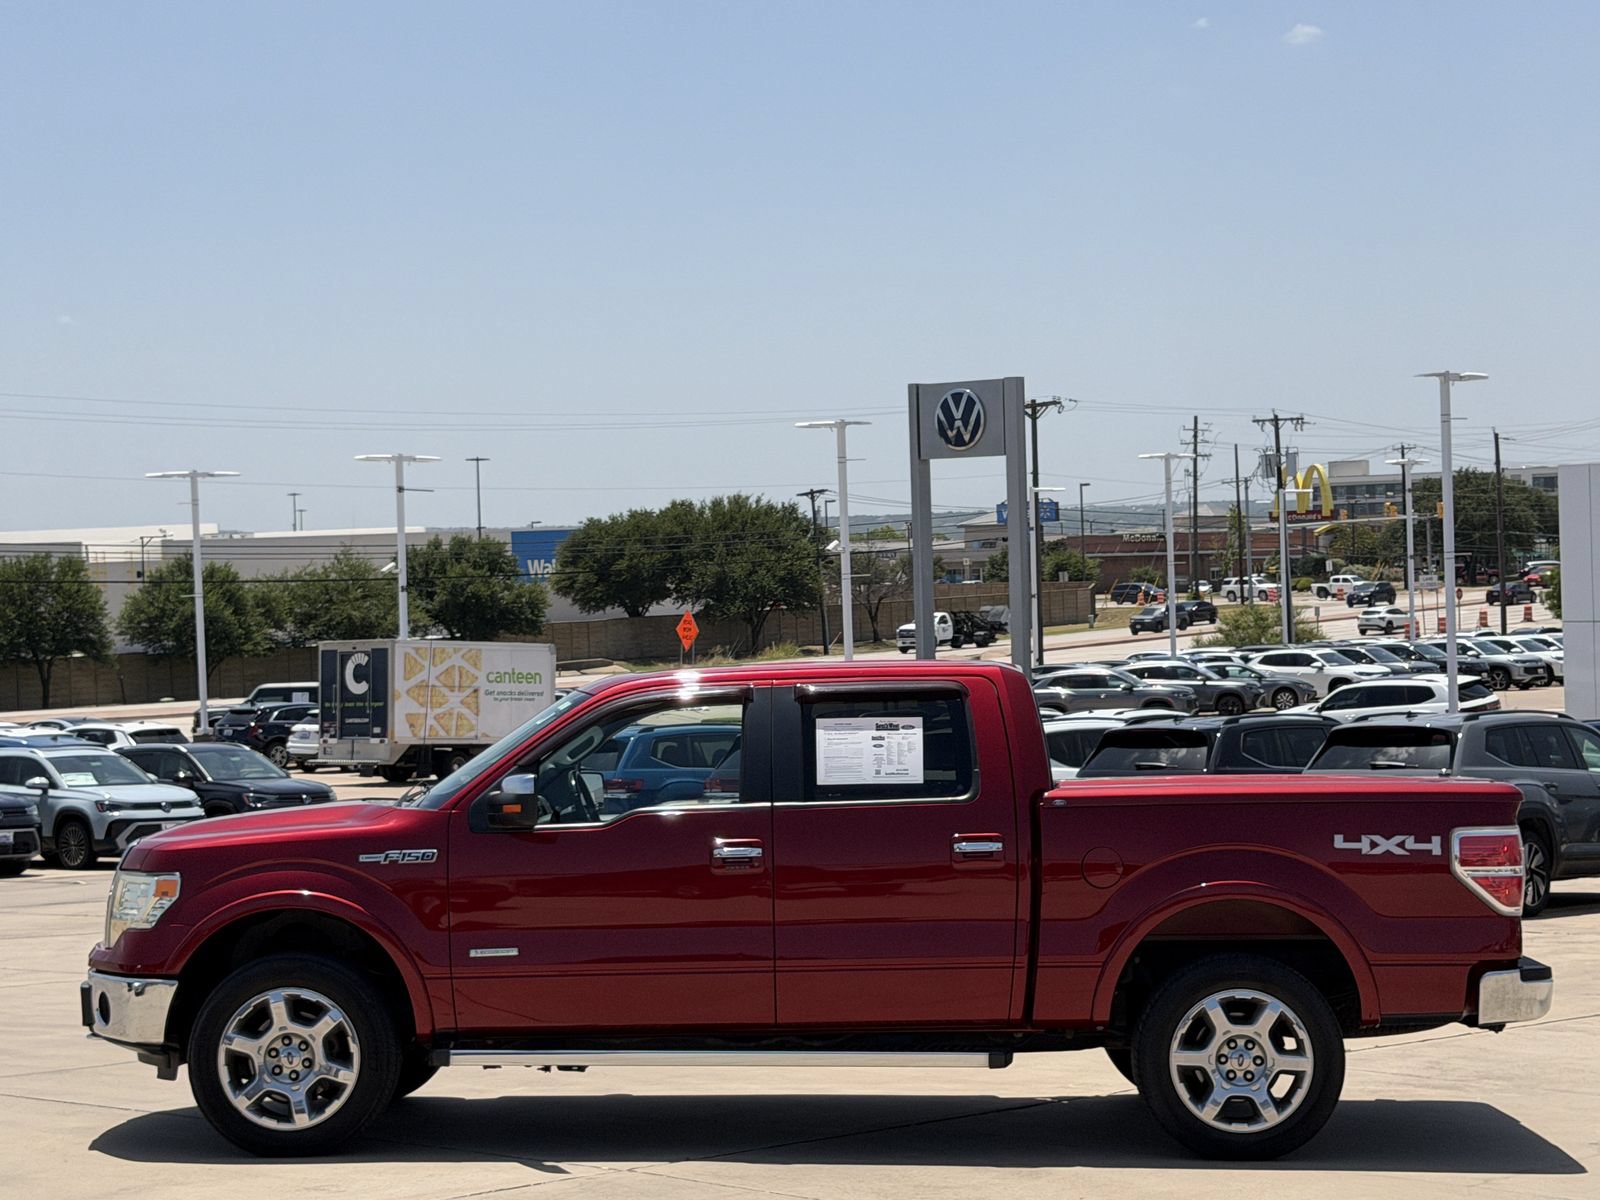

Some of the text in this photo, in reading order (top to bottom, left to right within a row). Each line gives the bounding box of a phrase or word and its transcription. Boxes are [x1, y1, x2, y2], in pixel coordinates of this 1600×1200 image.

[527, 558, 557, 578] Wal
[486, 667, 542, 685] canteen
[485, 689, 495, 697] Get
